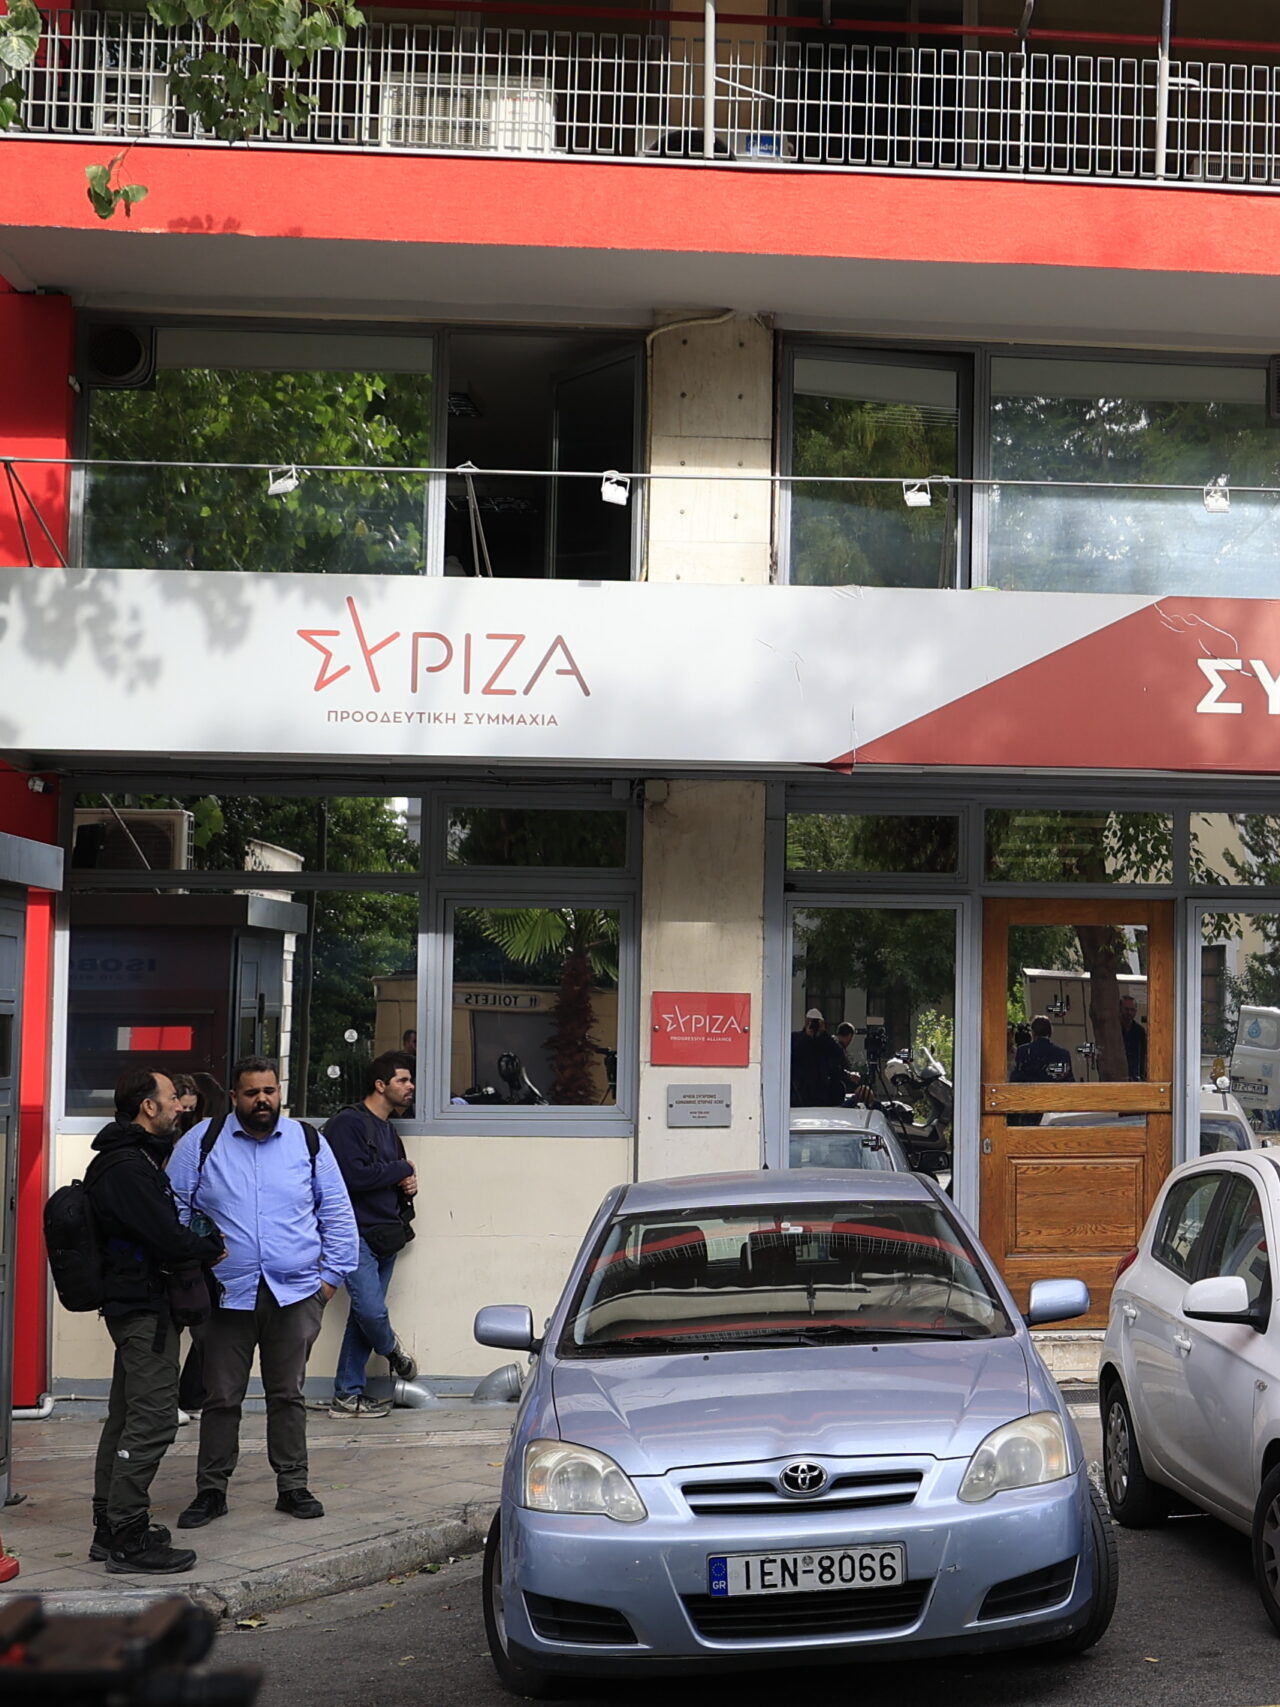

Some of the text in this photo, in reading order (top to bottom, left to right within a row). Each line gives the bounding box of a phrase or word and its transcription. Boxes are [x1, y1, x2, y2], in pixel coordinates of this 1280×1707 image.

[296, 596, 591, 697] ΣΥΡΙΖΑ
[327, 710, 558, 727] ΠΡΟΟΔΕΥΤΙΚΗ ΣΥΜΜΑΧΙΑ
[661, 1005, 742, 1034] ΣΥΡΙΖΑ
[712, 1580, 727, 1590] GR
